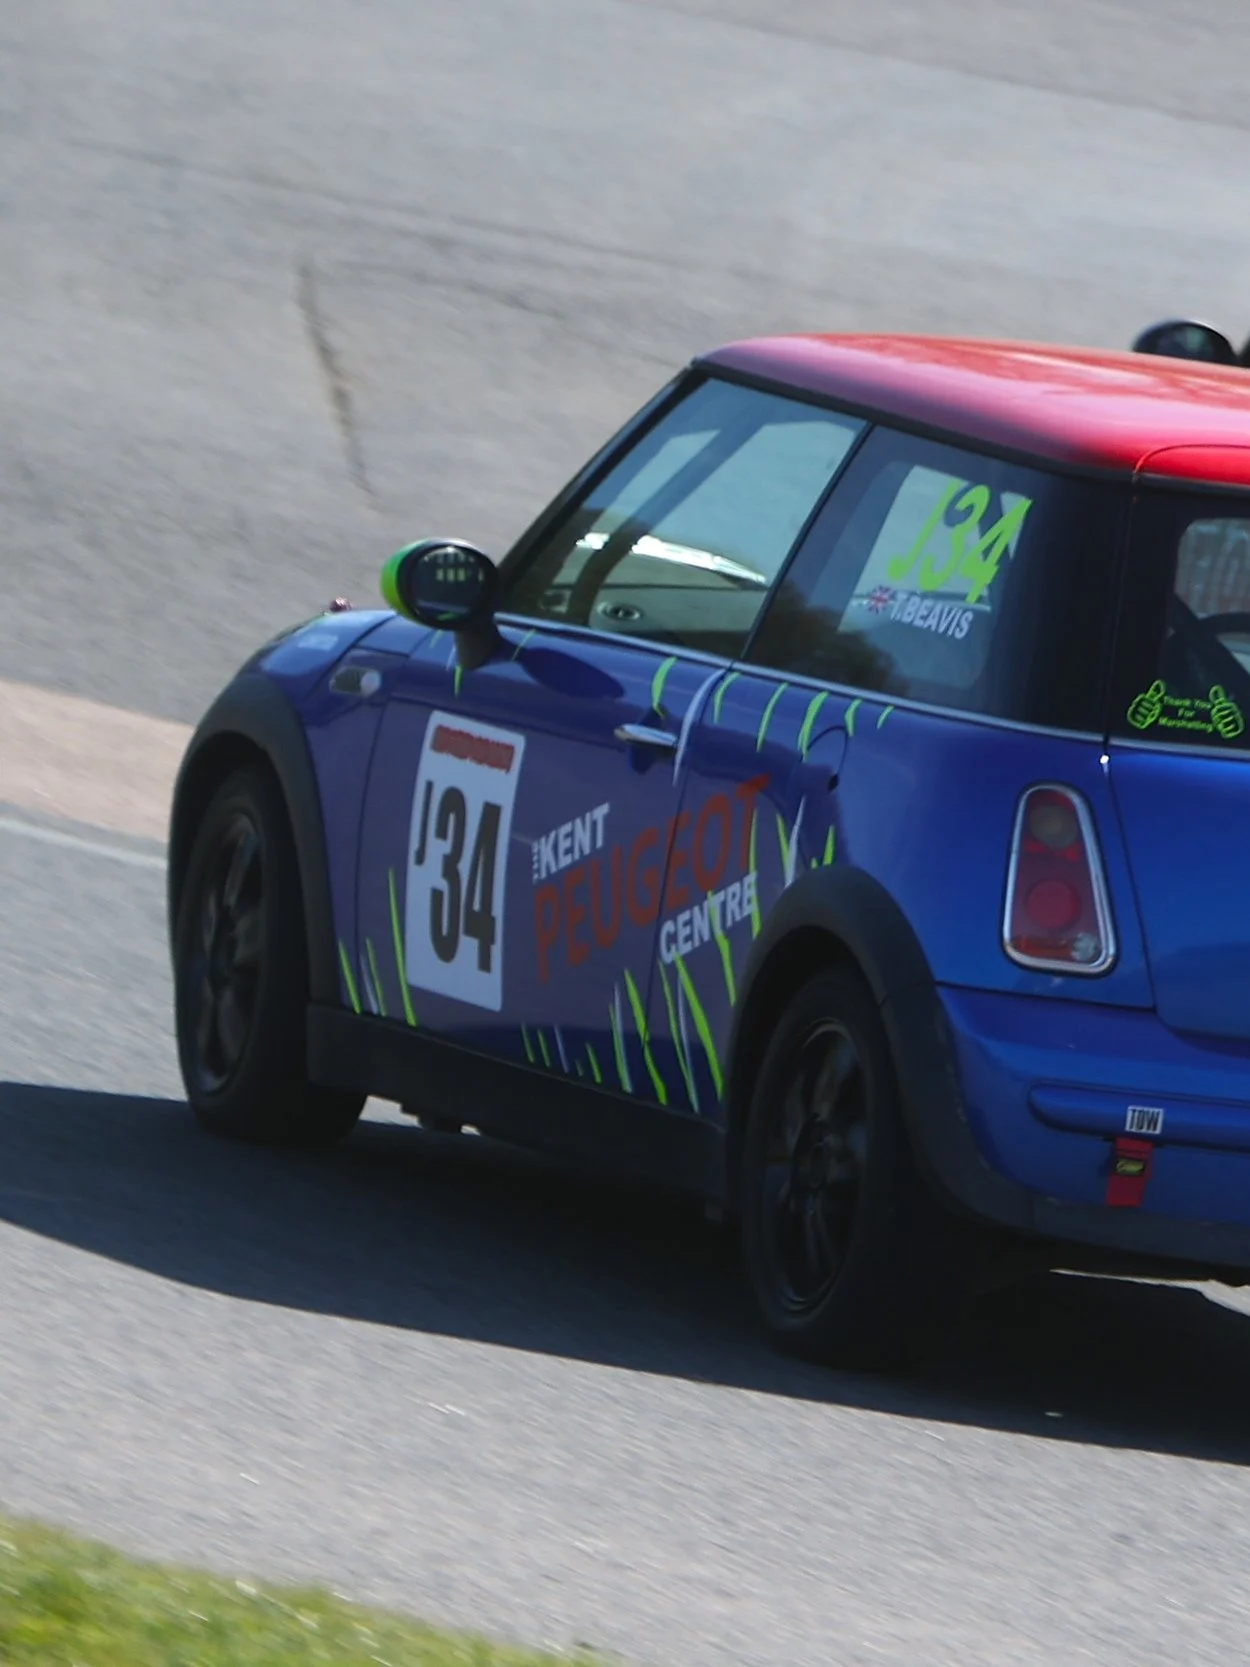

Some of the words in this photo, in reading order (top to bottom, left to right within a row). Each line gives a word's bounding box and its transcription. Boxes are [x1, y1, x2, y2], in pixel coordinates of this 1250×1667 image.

[888, 478, 1034, 605] J34
[533, 774, 770, 984] PEUGEOT
[539, 803, 610, 880] KENT
[659, 870, 759, 965] CENTRE
[1128, 1109, 1162, 1132] TOW
